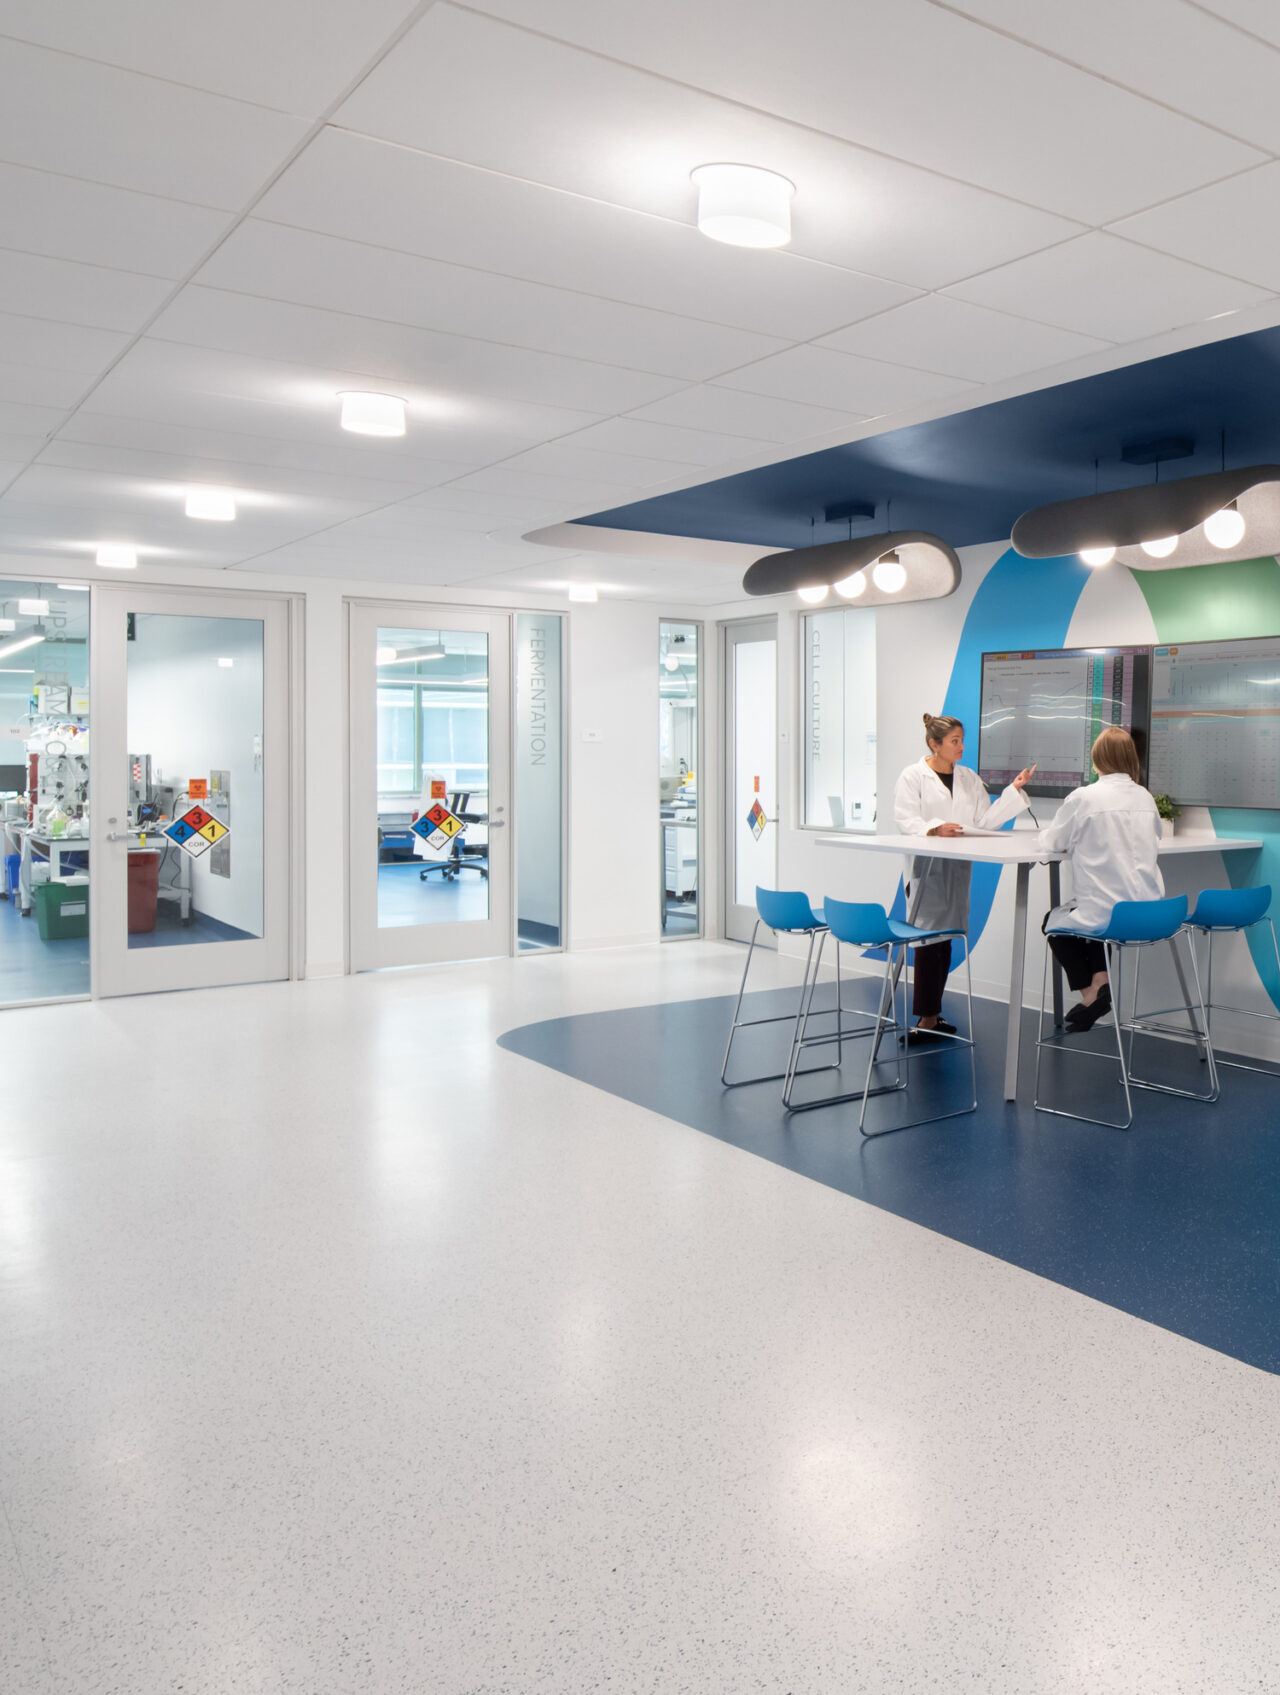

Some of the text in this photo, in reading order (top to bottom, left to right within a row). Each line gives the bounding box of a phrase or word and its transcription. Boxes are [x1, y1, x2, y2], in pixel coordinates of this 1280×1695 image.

[45, 600, 67, 715] UPSTREAM
[530, 628, 546, 766] FERMENTATION
[812, 630, 820, 761] CELL CULTURE
[192, 811, 203, 825] 3
[433, 809, 442, 821] 3
[175, 825, 186, 838] 4
[208, 825, 215, 837] 1
[421, 821, 429, 833] 3
[446, 821, 453, 832] 1
